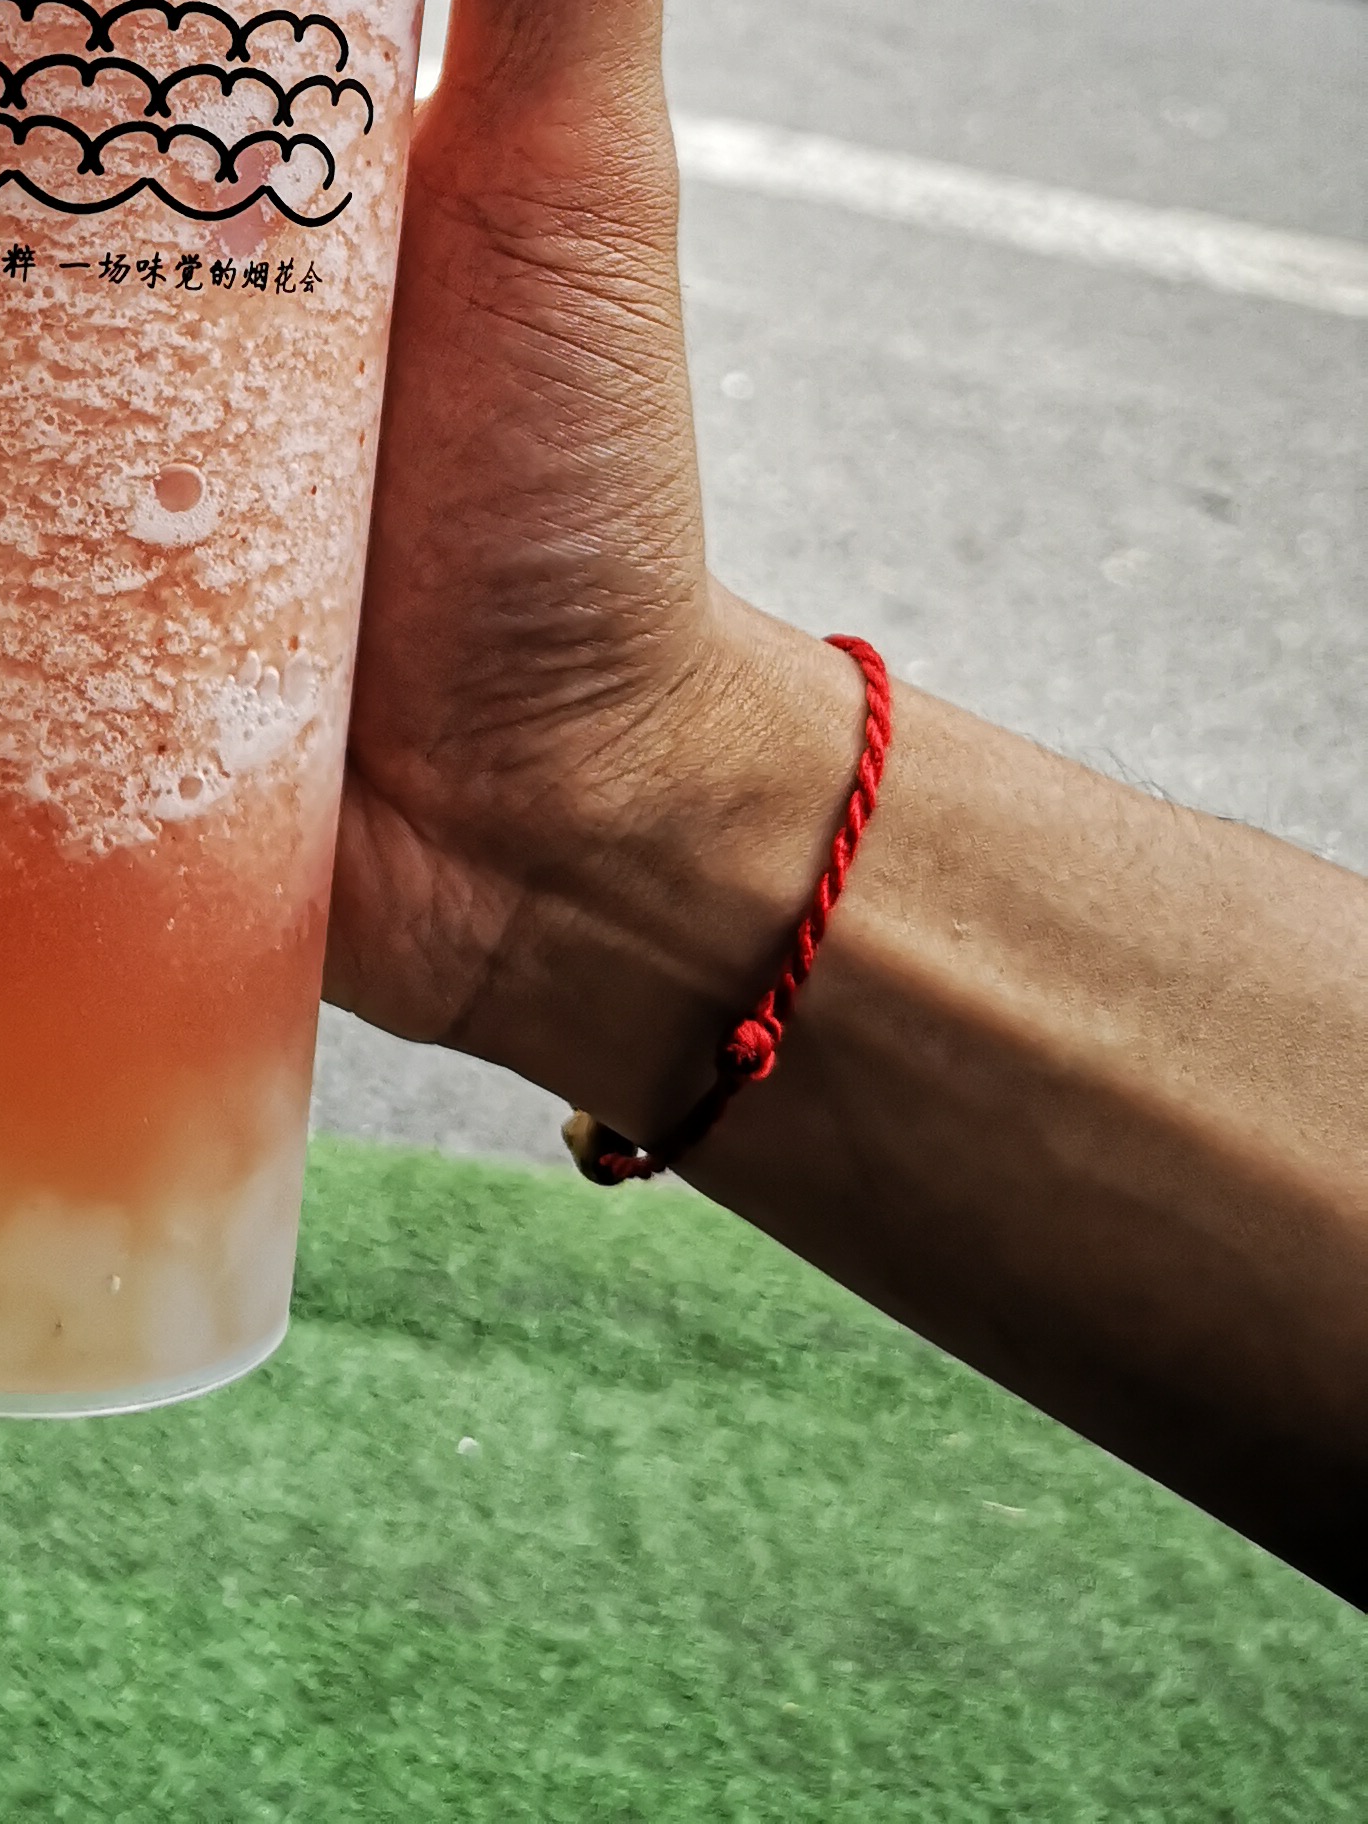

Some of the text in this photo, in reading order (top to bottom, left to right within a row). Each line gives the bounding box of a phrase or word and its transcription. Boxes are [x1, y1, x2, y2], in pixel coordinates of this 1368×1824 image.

[58, 251, 324, 295] 一场味觉的烟花会
